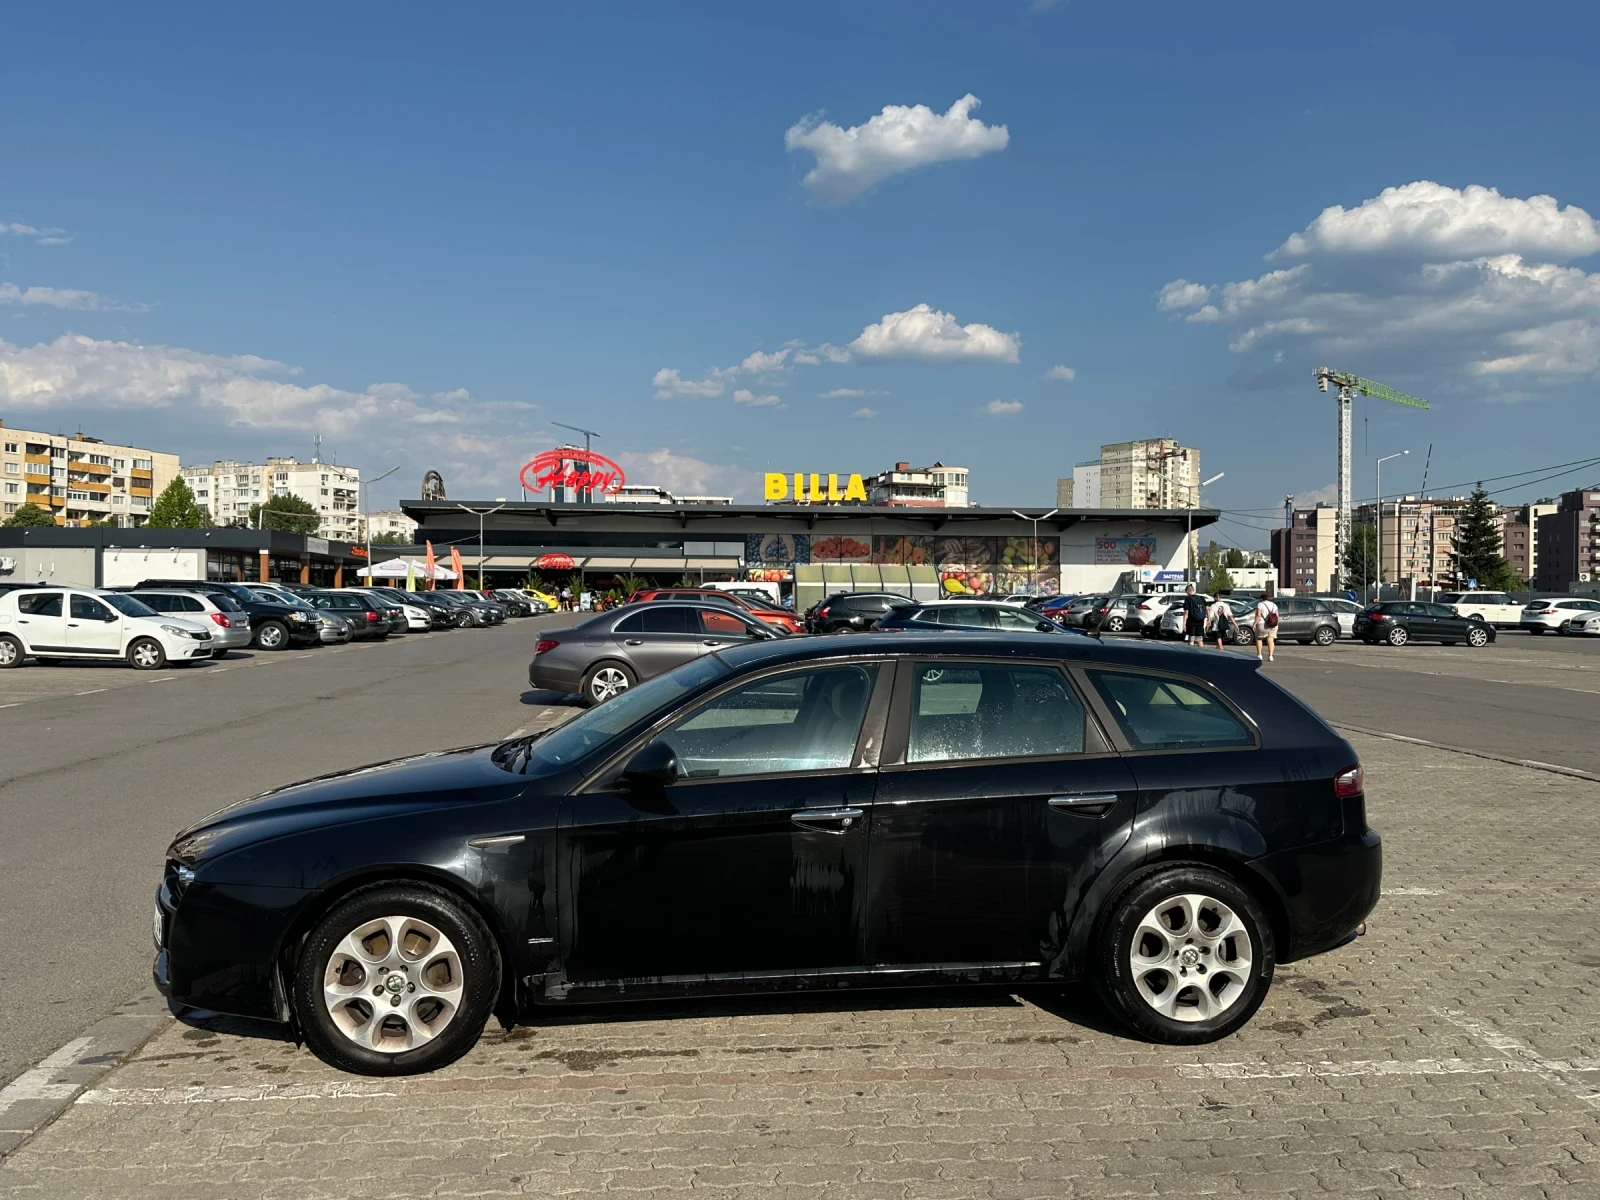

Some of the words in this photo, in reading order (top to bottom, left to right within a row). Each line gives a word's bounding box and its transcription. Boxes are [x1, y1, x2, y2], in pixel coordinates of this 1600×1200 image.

[532, 460, 616, 493] Happy
[764, 472, 867, 501] BILLA
[1097, 541, 1116, 550] 500
